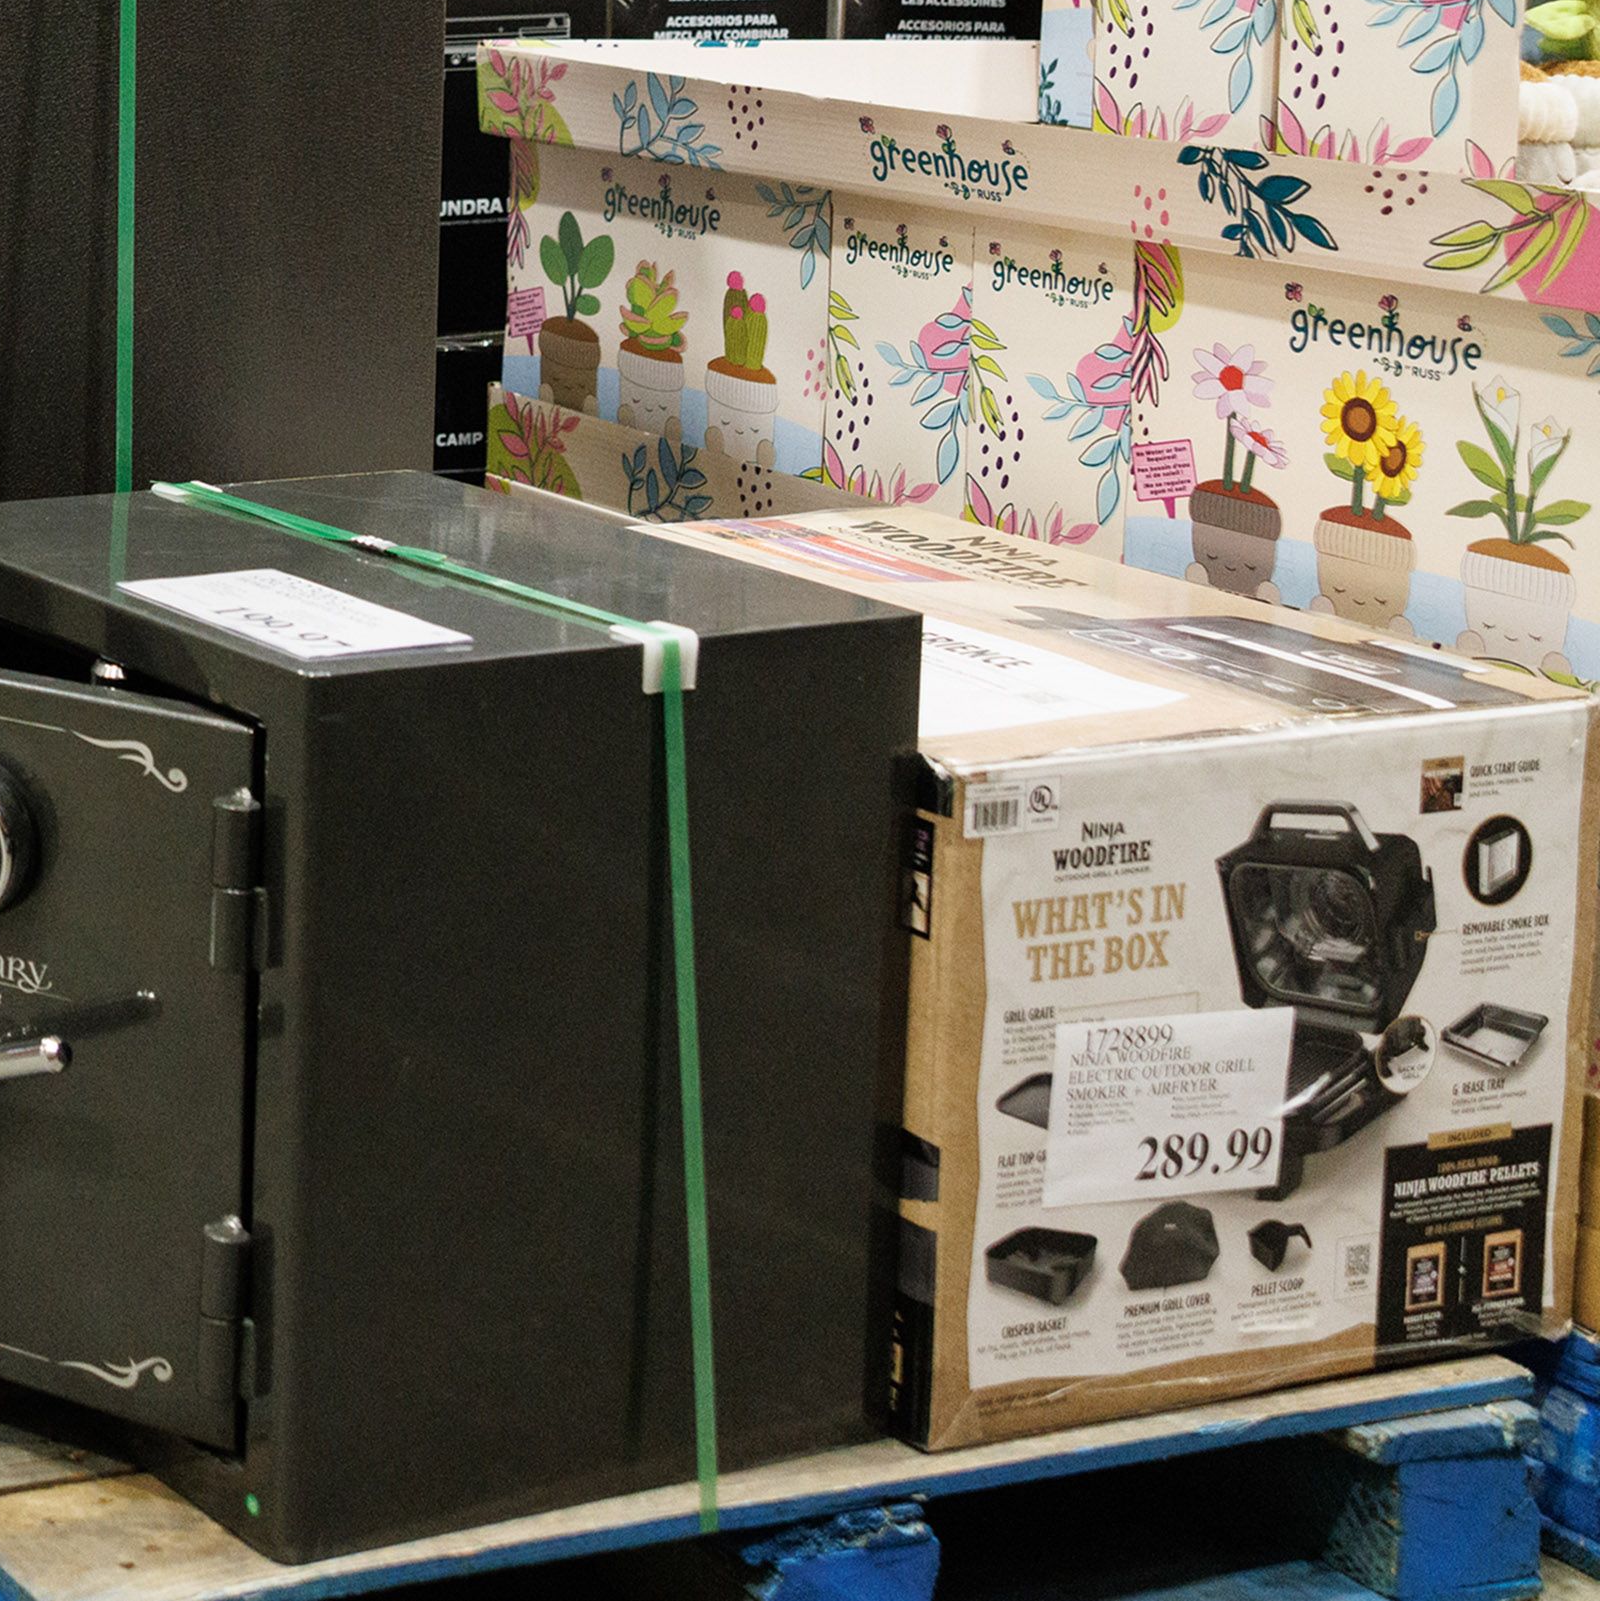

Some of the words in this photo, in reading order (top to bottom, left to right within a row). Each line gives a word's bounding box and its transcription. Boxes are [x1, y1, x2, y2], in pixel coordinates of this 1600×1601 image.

[870, 139, 1029, 197] greenhouse
[603, 186, 721, 236] greenhouse
[846, 233, 954, 276] greenhouse
[992, 259, 1114, 305] greenhouse
[1289, 308, 1482, 376] greenhouse
[436, 432, 483, 447] CAMP
[849, 519, 1090, 589] WOODFIRE
[950, 534, 1059, 567] NINJA
[1080, 821, 1127, 843] NINJA
[1053, 840, 1153, 871] WOODFIRE
[1150, 882, 1187, 924] IN
[1026, 939, 1097, 983] THE
[1102, 930, 1170, 975] BOX
[1085, 1023, 1174, 1052] 1728899
[1068, 1067, 1138, 1086] ELECTRIC
[1141, 1061, 1211, 1080] OUTDOOR
[1214, 1058, 1256, 1074] GRILL
[1069, 1052, 1113, 1068] NINJA
[1116, 1046, 1193, 1063] WOODFIRE
[1065, 1084, 1128, 1102] SMOKER
[1147, 1078, 1218, 1097] AIRFRYER
[1134, 1125, 1273, 1182] 289.99
[1394, 1179, 1427, 1197] NINJA
[1429, 1171, 1488, 1191] WOODFIRE
[1490, 1163, 1539, 1180] PELLETS
